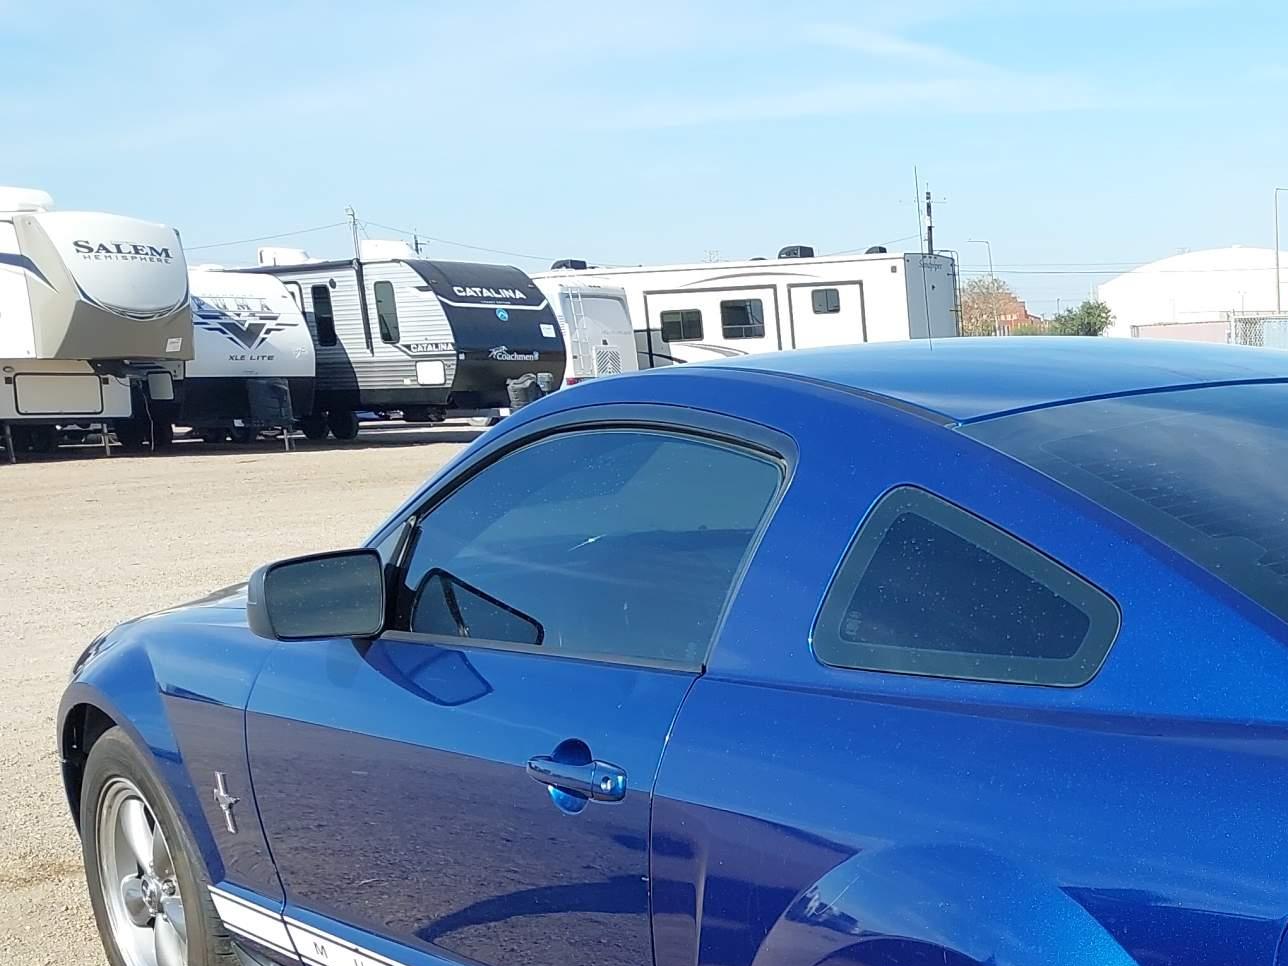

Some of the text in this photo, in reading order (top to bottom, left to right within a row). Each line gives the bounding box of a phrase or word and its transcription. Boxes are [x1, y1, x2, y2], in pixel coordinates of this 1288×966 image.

[72, 239, 173, 259] SALEM
[83, 254, 172, 264] HEMISPHERE
[452, 286, 527, 299] CATALINA
[410, 343, 454, 352] CATALINA
[496, 351, 533, 361] Coachmen
